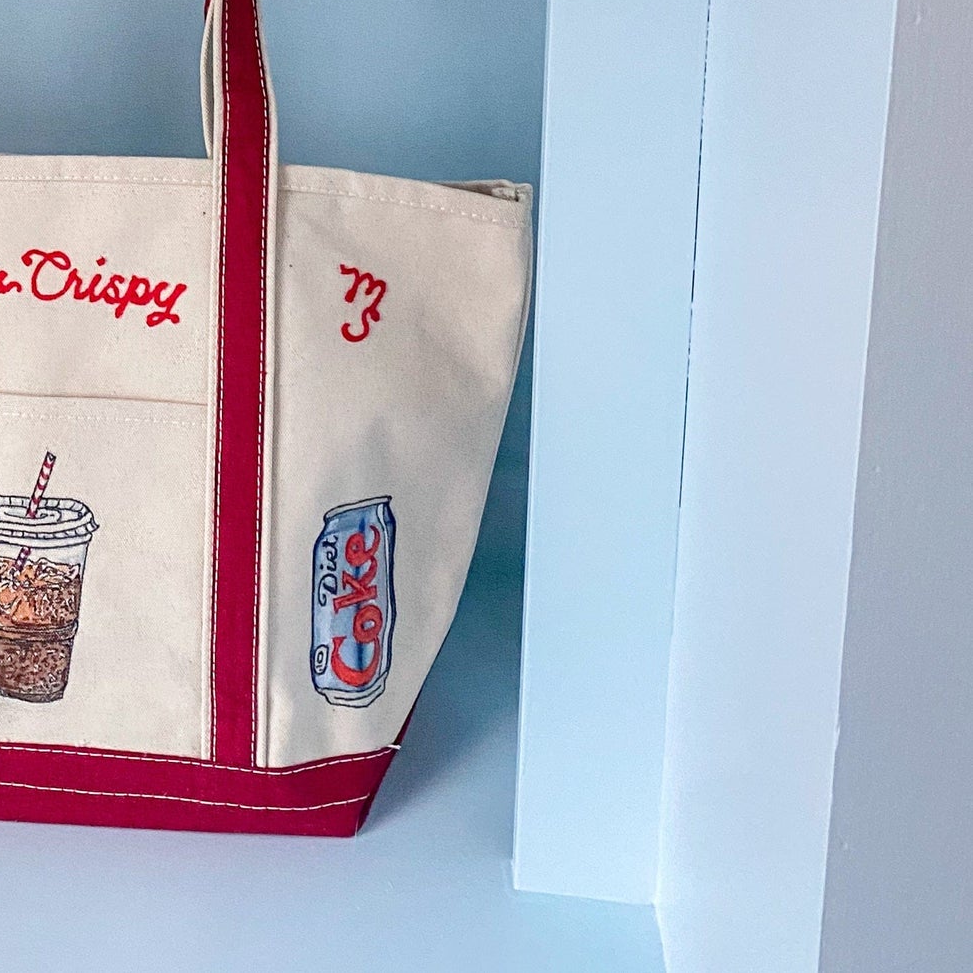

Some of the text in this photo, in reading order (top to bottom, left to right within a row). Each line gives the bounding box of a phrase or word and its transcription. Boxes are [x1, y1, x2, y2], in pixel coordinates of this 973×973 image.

[21, 248, 188, 328] Crispy
[317, 534, 339, 608] Diet
[331, 526, 383, 687] Coke
